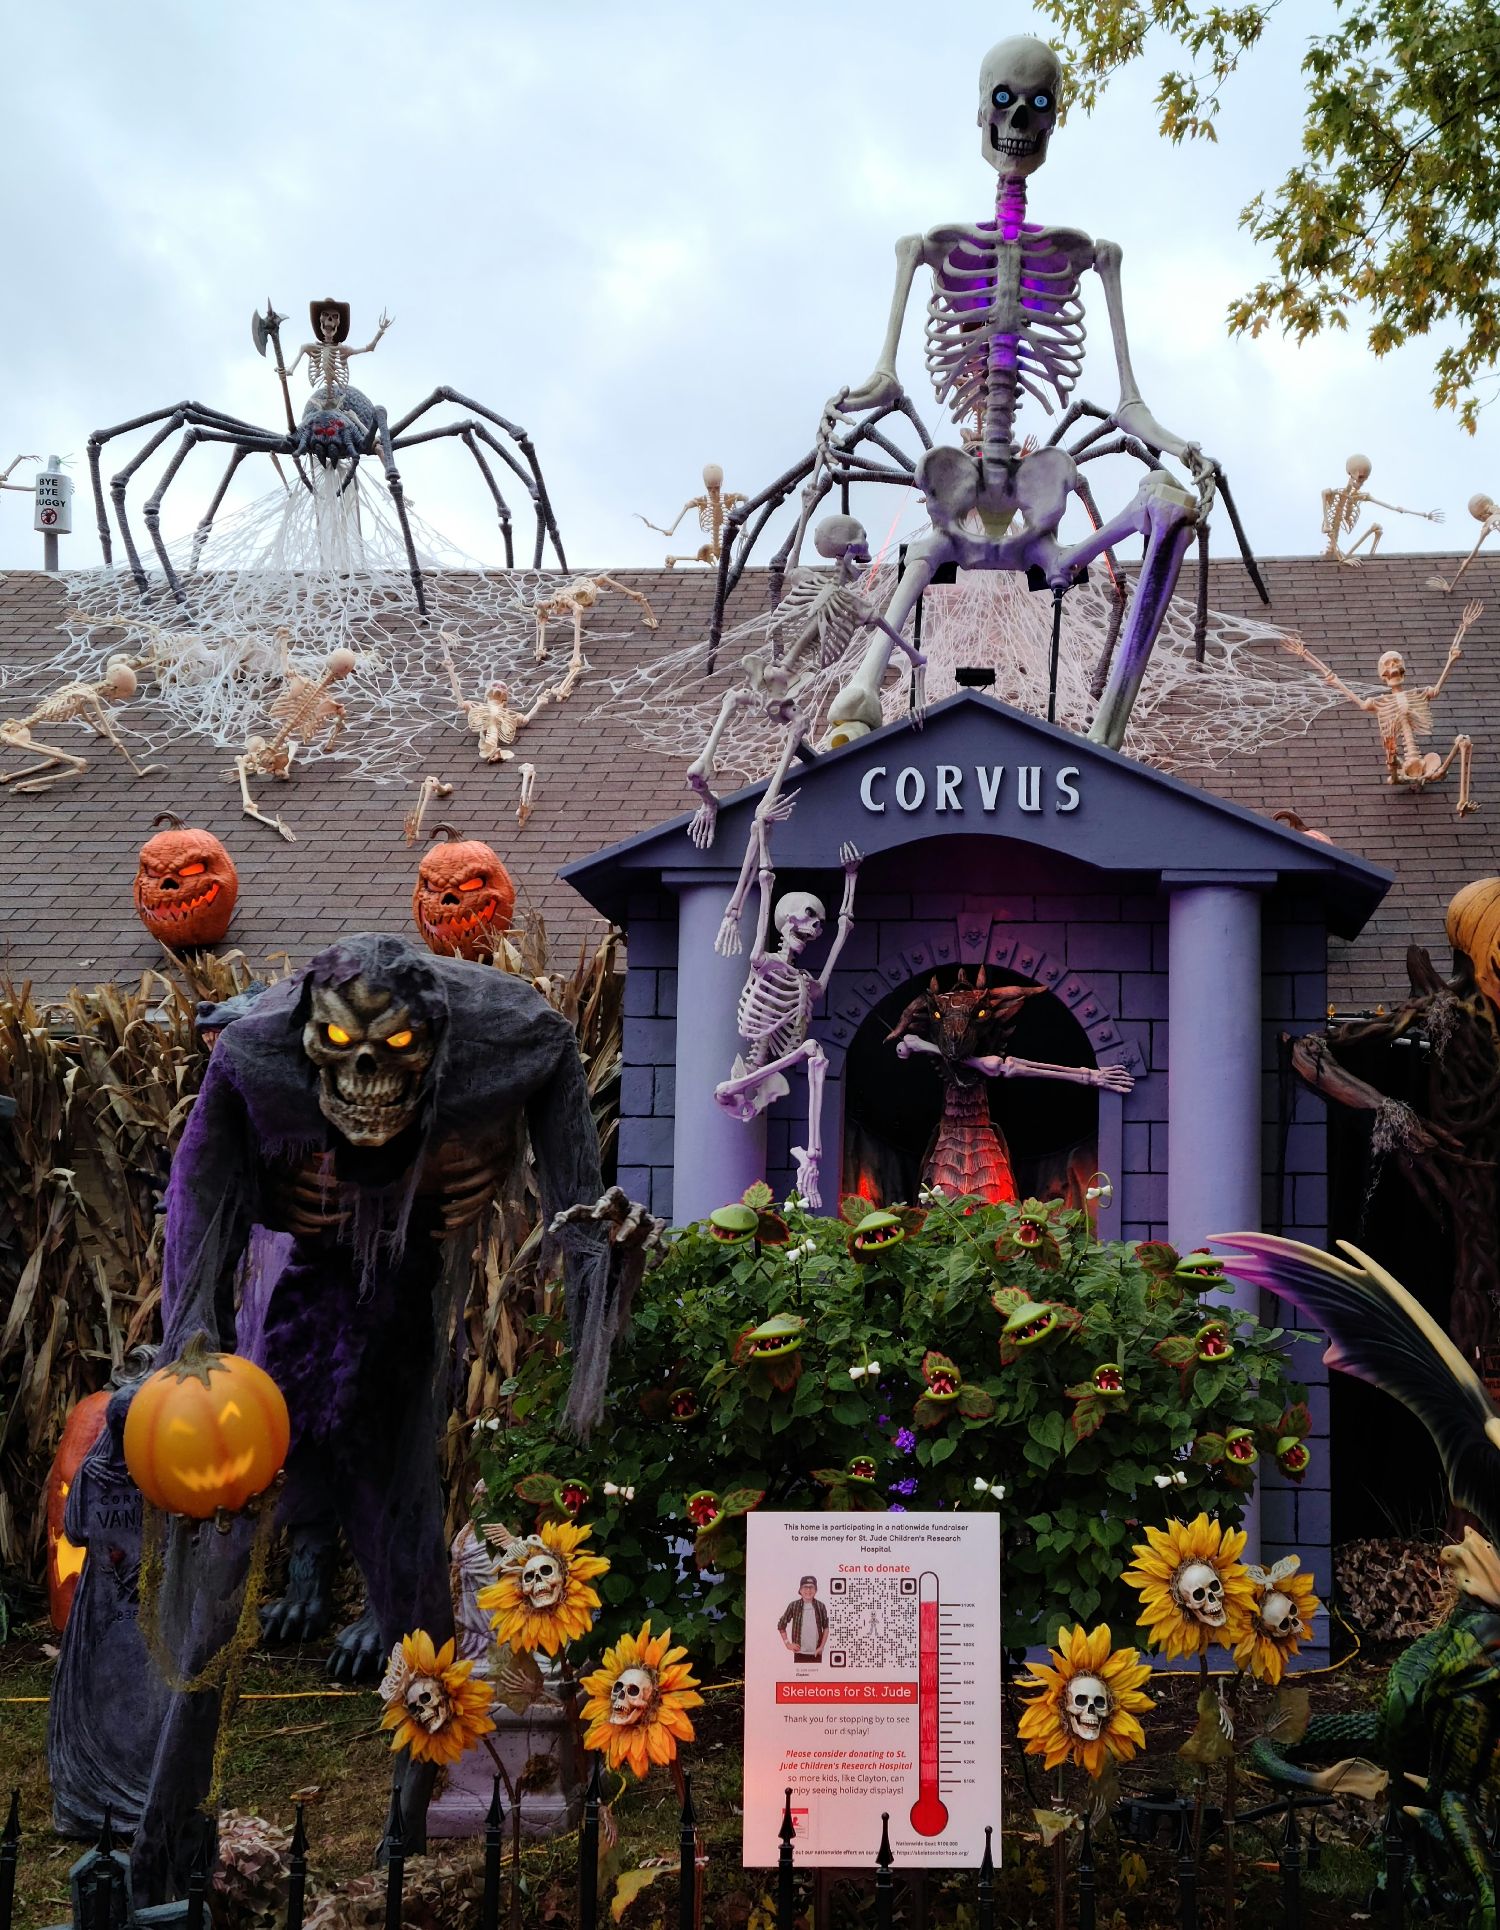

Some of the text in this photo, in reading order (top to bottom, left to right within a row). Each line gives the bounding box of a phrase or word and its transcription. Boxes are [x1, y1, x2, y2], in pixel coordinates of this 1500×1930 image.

[39, 478, 58, 486] BYE
[39, 488, 58, 496] BYE
[860, 765, 1080, 812] CORVUS
[784, 1523, 969, 1531] This home is participating in a nationwide fundraiser
[791, 1534, 961, 1542] to raise money for St. Jude Children's Research
[838, 1563, 910, 1573] Scan to donate
[782, 1685, 912, 1698] Skeletons for St. Jude
[783, 1714, 808, 1723] Thank
[809, 1716, 824, 1725] you
[826, 1714, 836, 1723] for
[839, 1715, 874, 1725] stopping
[875, 1714, 885, 1725] by
[886, 1715, 894, 1723] to
[785, 1750, 907, 1760] Please consider donating to St.
[778, 1762, 913, 1772] Jude Children's Research Hospital
[821, 1774, 840, 1784] kids,
[841, 1774, 856, 1782] like
[857, 1774, 889, 1784] Clayton,
[792, 1786, 904, 1796] njoy seeing holiday displays!
